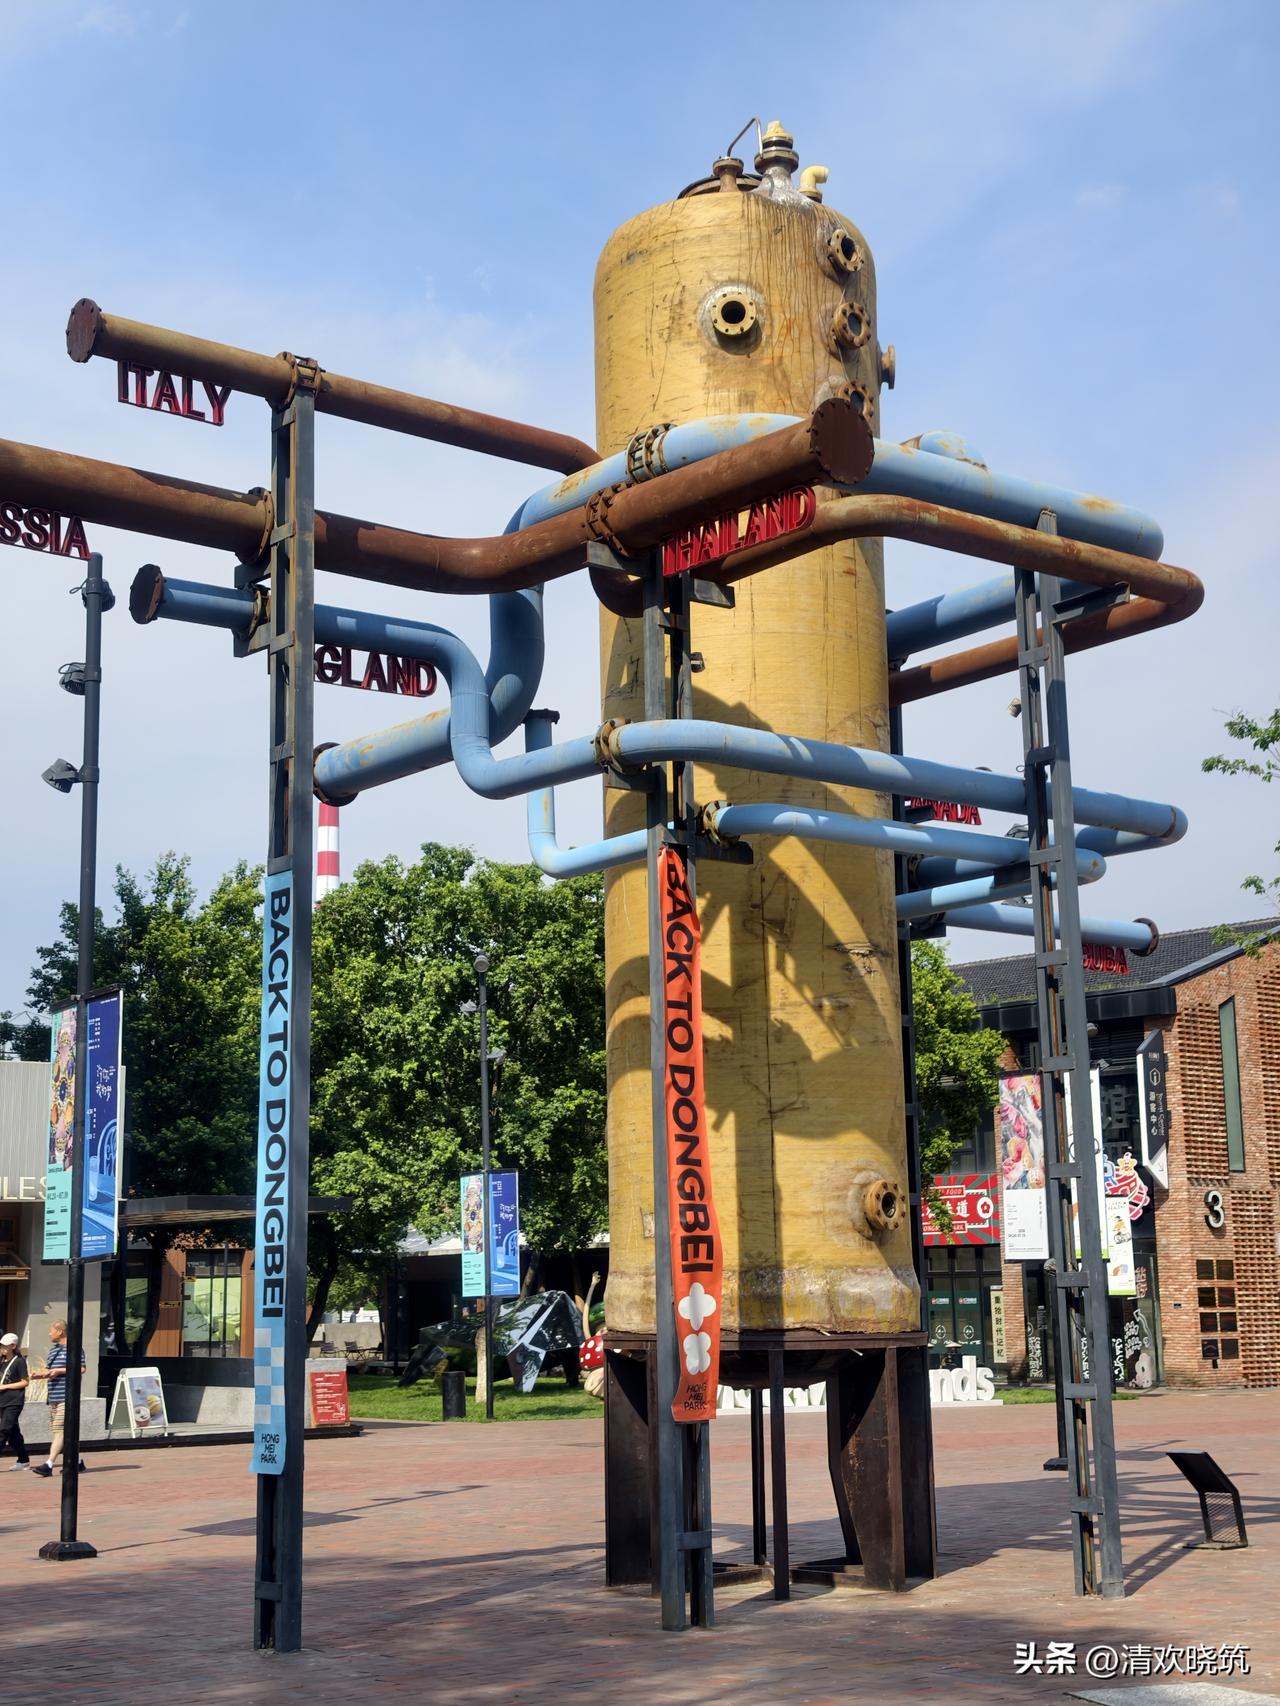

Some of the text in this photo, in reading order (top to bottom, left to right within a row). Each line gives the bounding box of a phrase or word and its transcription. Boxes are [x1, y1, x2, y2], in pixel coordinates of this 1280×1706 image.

[118, 360, 232, 427] ITALY
[662, 485, 817, 577] THAILAND
[313, 644, 438, 698] GLAND
[667, 863, 714, 1274] BACK TO DONGBEI
[262, 887, 290, 1317] BACK TO DONGBEI
[0, 1176, 47, 1200] LES
[1204, 1190, 1225, 1228] 3
[683, 1400, 707, 1412] PARK
[261, 1433, 280, 1444] HONG
[264, 1444, 275, 1453] MEI
[260, 1454, 278, 1464] PARK
